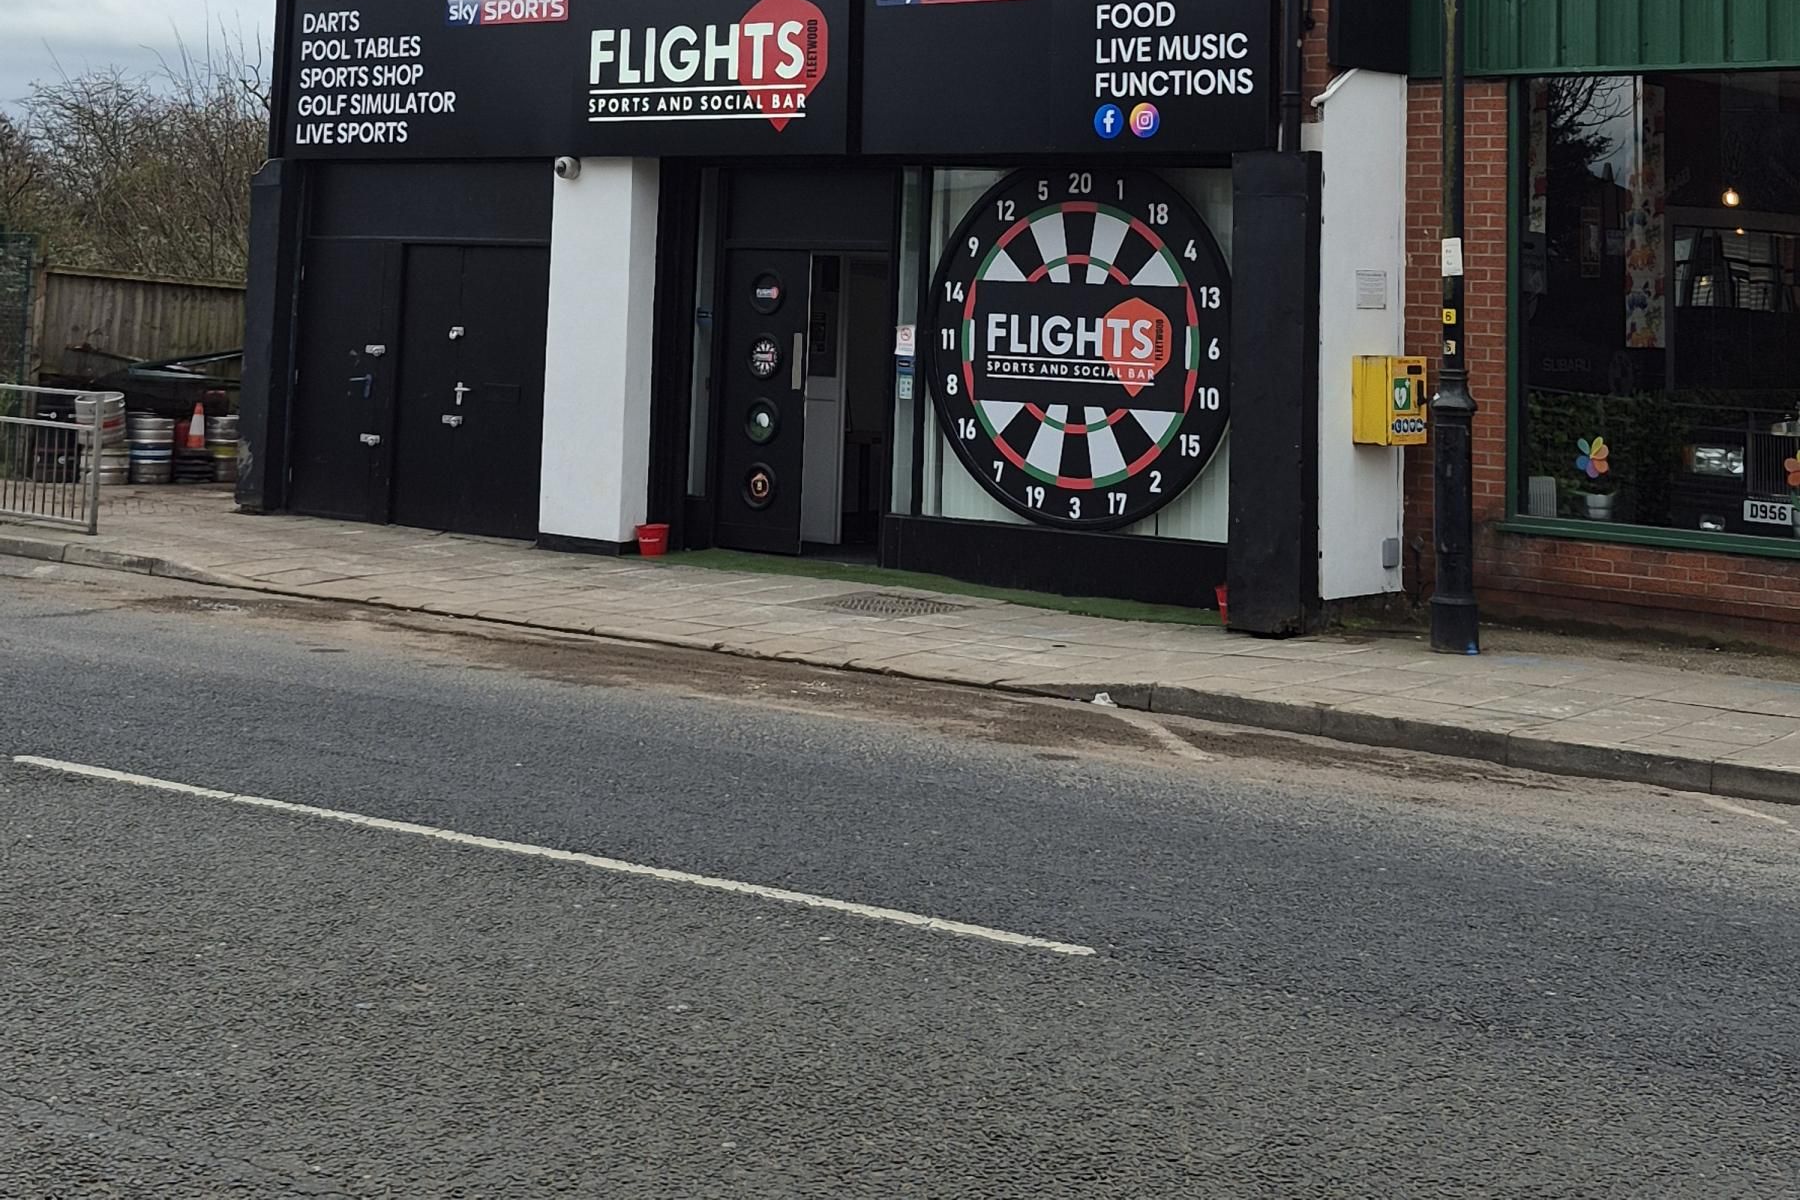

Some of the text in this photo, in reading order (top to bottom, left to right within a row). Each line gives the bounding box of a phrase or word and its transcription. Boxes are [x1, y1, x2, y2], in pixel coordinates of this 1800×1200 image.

[302, 10, 360, 33] DARTS
[449, 0, 479, 25] sky
[1096, 1, 1176, 29] FOOD
[301, 35, 421, 61] POOL TABLES
[589, 20, 805, 85] FLIGHTS
[806, 19, 818, 79] FLEETWOOD
[1096, 32, 1249, 64] LIVE MUSIC
[299, 63, 424, 89] SPORTS SHOP
[1095, 68, 1253, 98] FUNCTIONS
[298, 91, 456, 116] GOLF SIMULATOR
[588, 93, 806, 113] SPORTS AND SOCIAL BAR
[296, 121, 408, 144] LIVE SPORTS
[1038, 180, 1049, 200] 5
[1069, 173, 1092, 194] 20
[1117, 179, 1124, 199] 1
[997, 200, 1015, 221] 12
[1149, 203, 1168, 224] 18
[968, 237, 979, 257] 9
[1184, 240, 1197, 261] 4
[945, 282, 964, 302] 14
[1200, 287, 1220, 308] 13
[941, 329, 955, 350] 11
[987, 313, 1154, 360] FLIGHTS
[1155, 319, 1164, 361] FLEETWOOD
[1208, 338, 1220, 360] 6
[987, 361, 1155, 380] SPORTS AND SOCIAL BAR
[1543, 358, 1591, 372] SUBARU
[946, 374, 958, 395] 8
[1198, 388, 1219, 410] 10
[958, 418, 976, 440] 16
[1180, 435, 1200, 456] 15
[993, 461, 1004, 482] 7
[1150, 471, 1162, 493] 2
[1026, 486, 1045, 508] 19
[1108, 492, 1127, 514] 17
[1069, 498, 1081, 519] 3
[1750, 503, 1787, 521] D956
